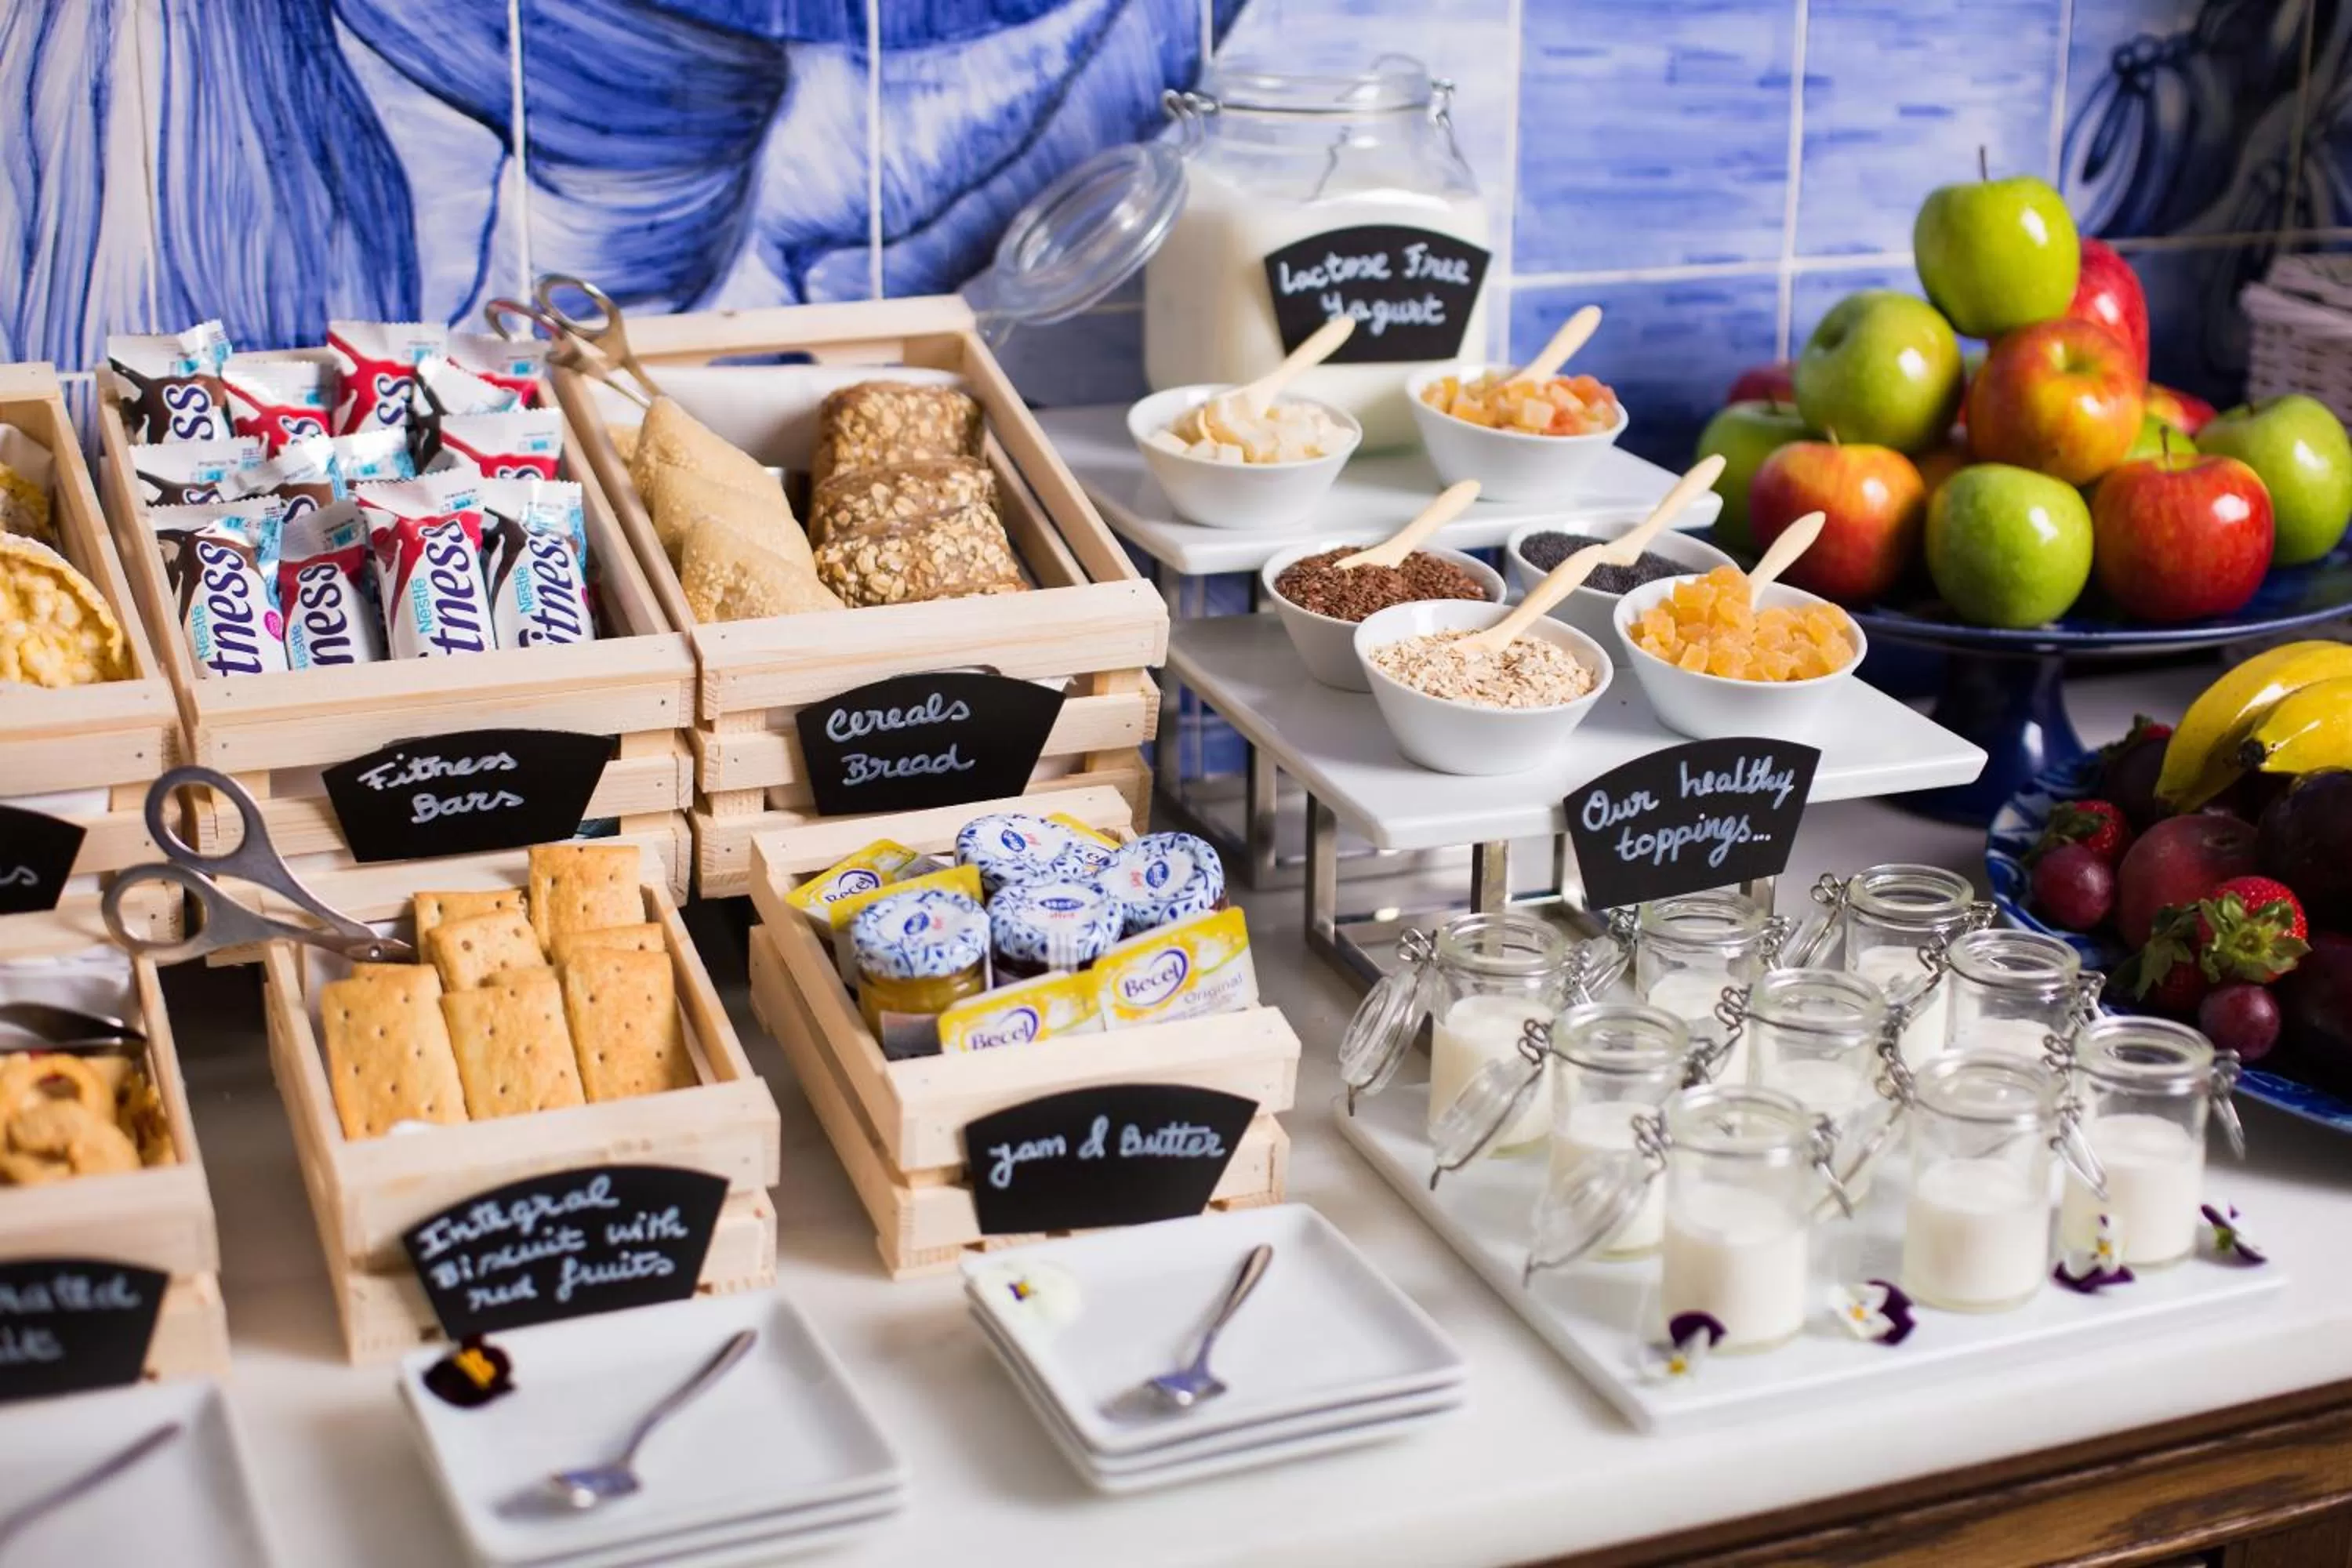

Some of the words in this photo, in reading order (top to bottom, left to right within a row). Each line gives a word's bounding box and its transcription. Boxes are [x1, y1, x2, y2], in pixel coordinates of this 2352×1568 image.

[1401, 241, 1472, 285] Free
[518, 524, 583, 646] itnes
[826, 692, 972, 743] Cereals
[357, 751, 521, 792] Fitness
[840, 742, 977, 787] Bread
[410, 788, 525, 825] Bars
[1582, 789, 1661, 832] Our
[1679, 755, 1795, 810] healthy
[1124, 964, 1179, 998] Becel
[971, 1019, 1030, 1051] Becel
[1119, 1120, 1227, 1158] Butter
[417, 1174, 620, 1260] Integral
[605, 1206, 690, 1246] with
[554, 1252, 676, 1303] fruits
